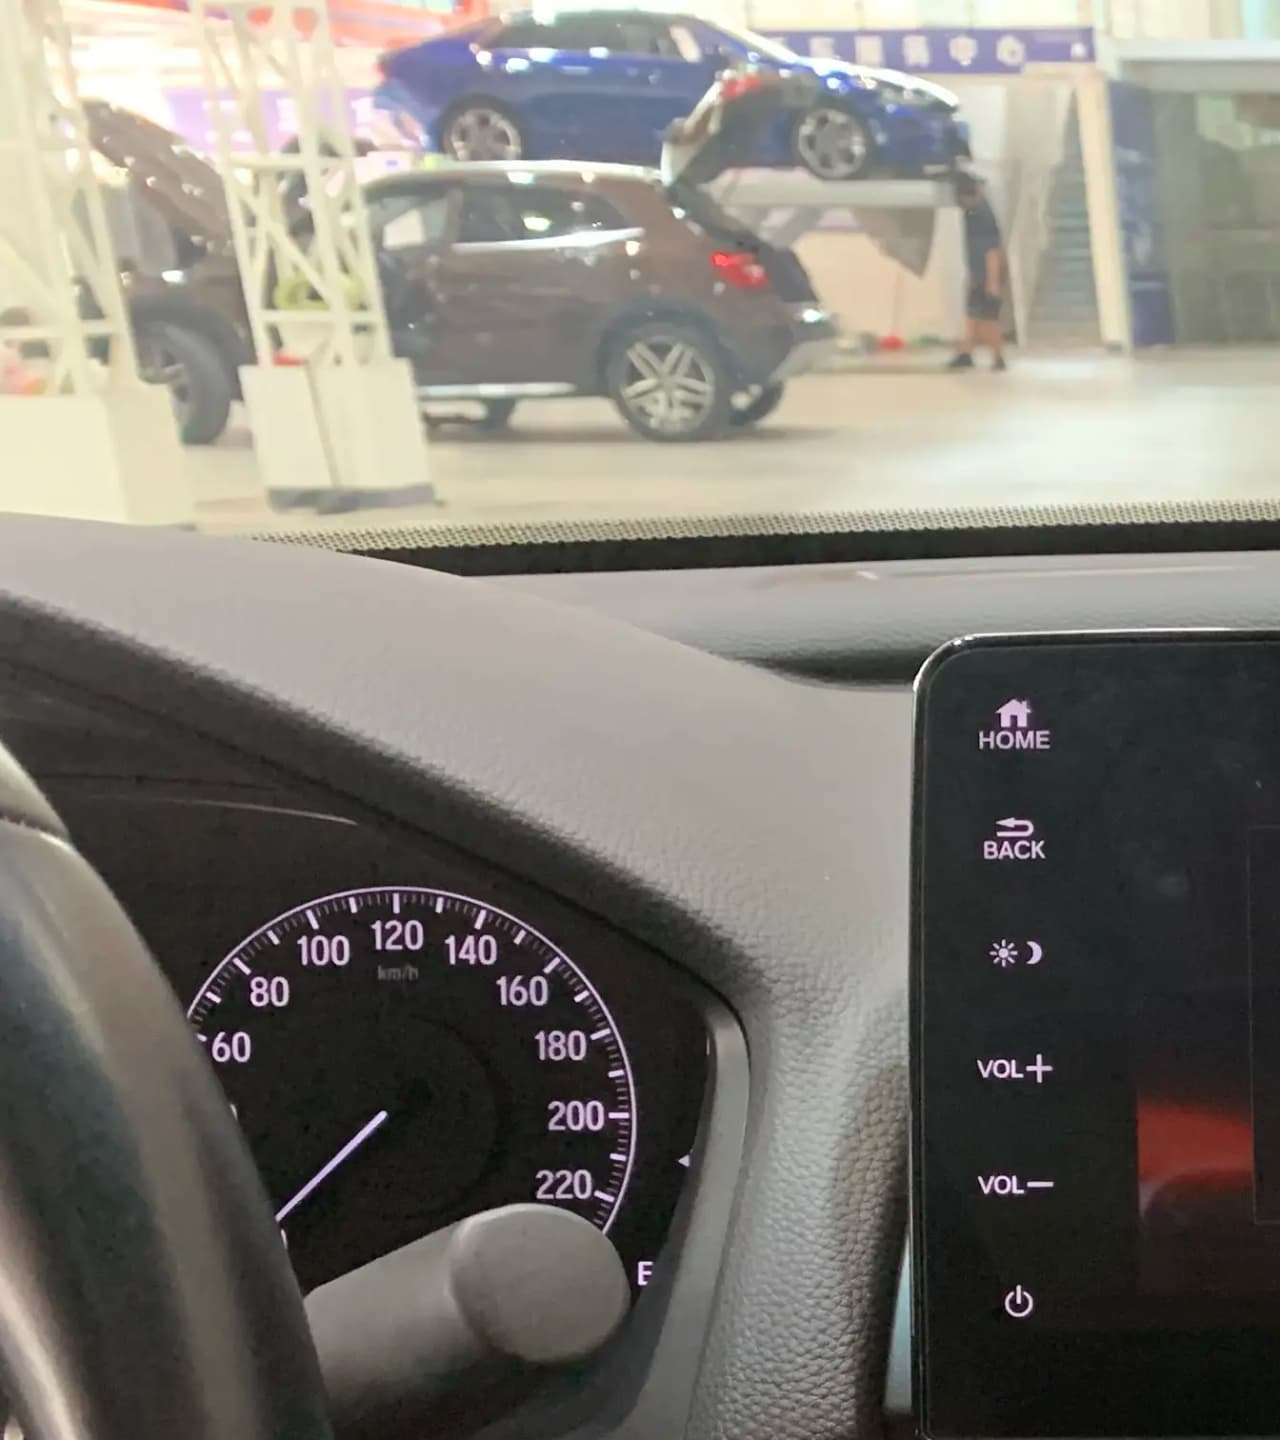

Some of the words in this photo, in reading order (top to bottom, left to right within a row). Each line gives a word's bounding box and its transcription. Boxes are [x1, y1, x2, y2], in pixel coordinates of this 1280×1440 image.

[978, 730, 1051, 750] HOME
[983, 840, 1047, 860] BACK
[297, 935, 350, 966] 100
[370, 919, 424, 951] 120
[445, 934, 498, 966] 140
[377, 964, 419, 981] km/h
[249, 976, 290, 1007] 80
[496, 975, 549, 1007] 160
[211, 1031, 252, 1063] 60
[535, 1030, 588, 1061] 180
[547, 1100, 605, 1131] 200
[535, 1169, 593, 1200] 220
[637, 1261, 653, 1286] E
